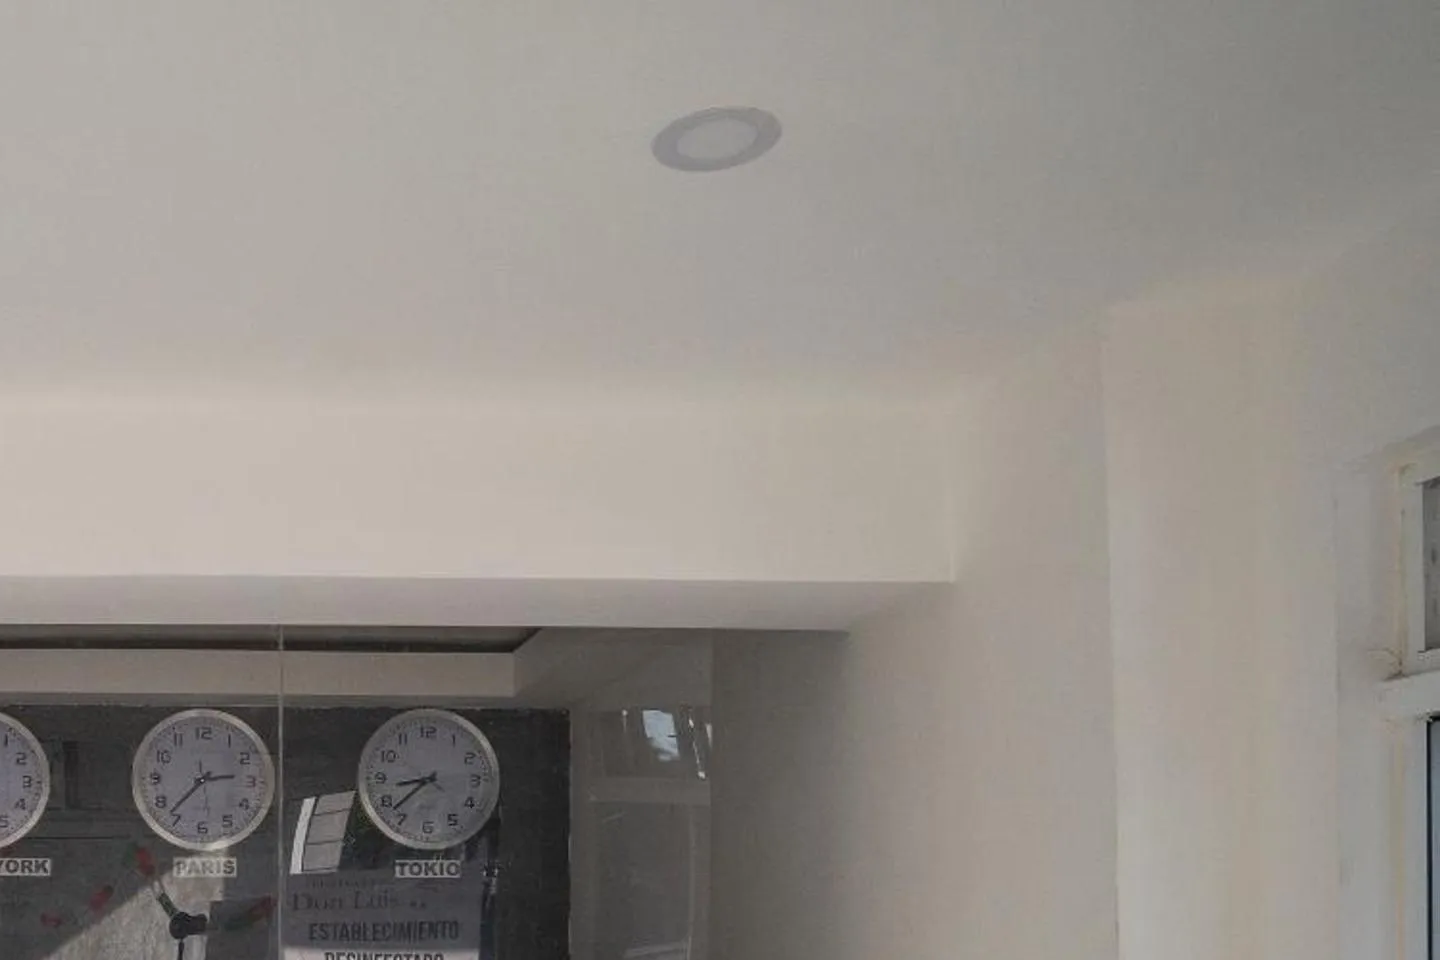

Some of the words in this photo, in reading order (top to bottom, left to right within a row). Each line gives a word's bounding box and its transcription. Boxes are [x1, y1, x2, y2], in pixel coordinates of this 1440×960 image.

[195, 726, 212, 740] 12
[398, 733, 408, 745] 11
[420, 726, 437, 739] 12
[3, 734, 9, 746] 1
[174, 734, 183, 746] 11
[227, 734, 232, 748] 1
[451, 734, 457, 747] 1
[16, 752, 27, 765] 2
[156, 750, 171, 764] 10
[239, 752, 250, 765] 2
[380, 750, 397, 763] 10
[464, 752, 476, 765] 2
[22, 775, 32, 789] 3
[150, 772, 161, 785] 9
[245, 775, 256, 788] 3
[374, 771, 386, 784] 9
[470, 774, 481, 788] 3
[15, 798, 26, 810] 4
[155, 795, 167, 809] 8
[239, 798, 250, 810] 4
[380, 795, 393, 808] 8
[464, 796, 475, 809] 4
[171, 813, 181, 827] 7
[222, 815, 233, 828] 5
[397, 813, 407, 826] 7
[447, 814, 458, 826] 5
[197, 821, 208, 835] 6
[422, 821, 435, 834] 6
[174, 859, 236, 875] PARIS
[397, 861, 461, 877] TOKIO
[308, 919, 460, 943] ESTABLECIMIENTO
